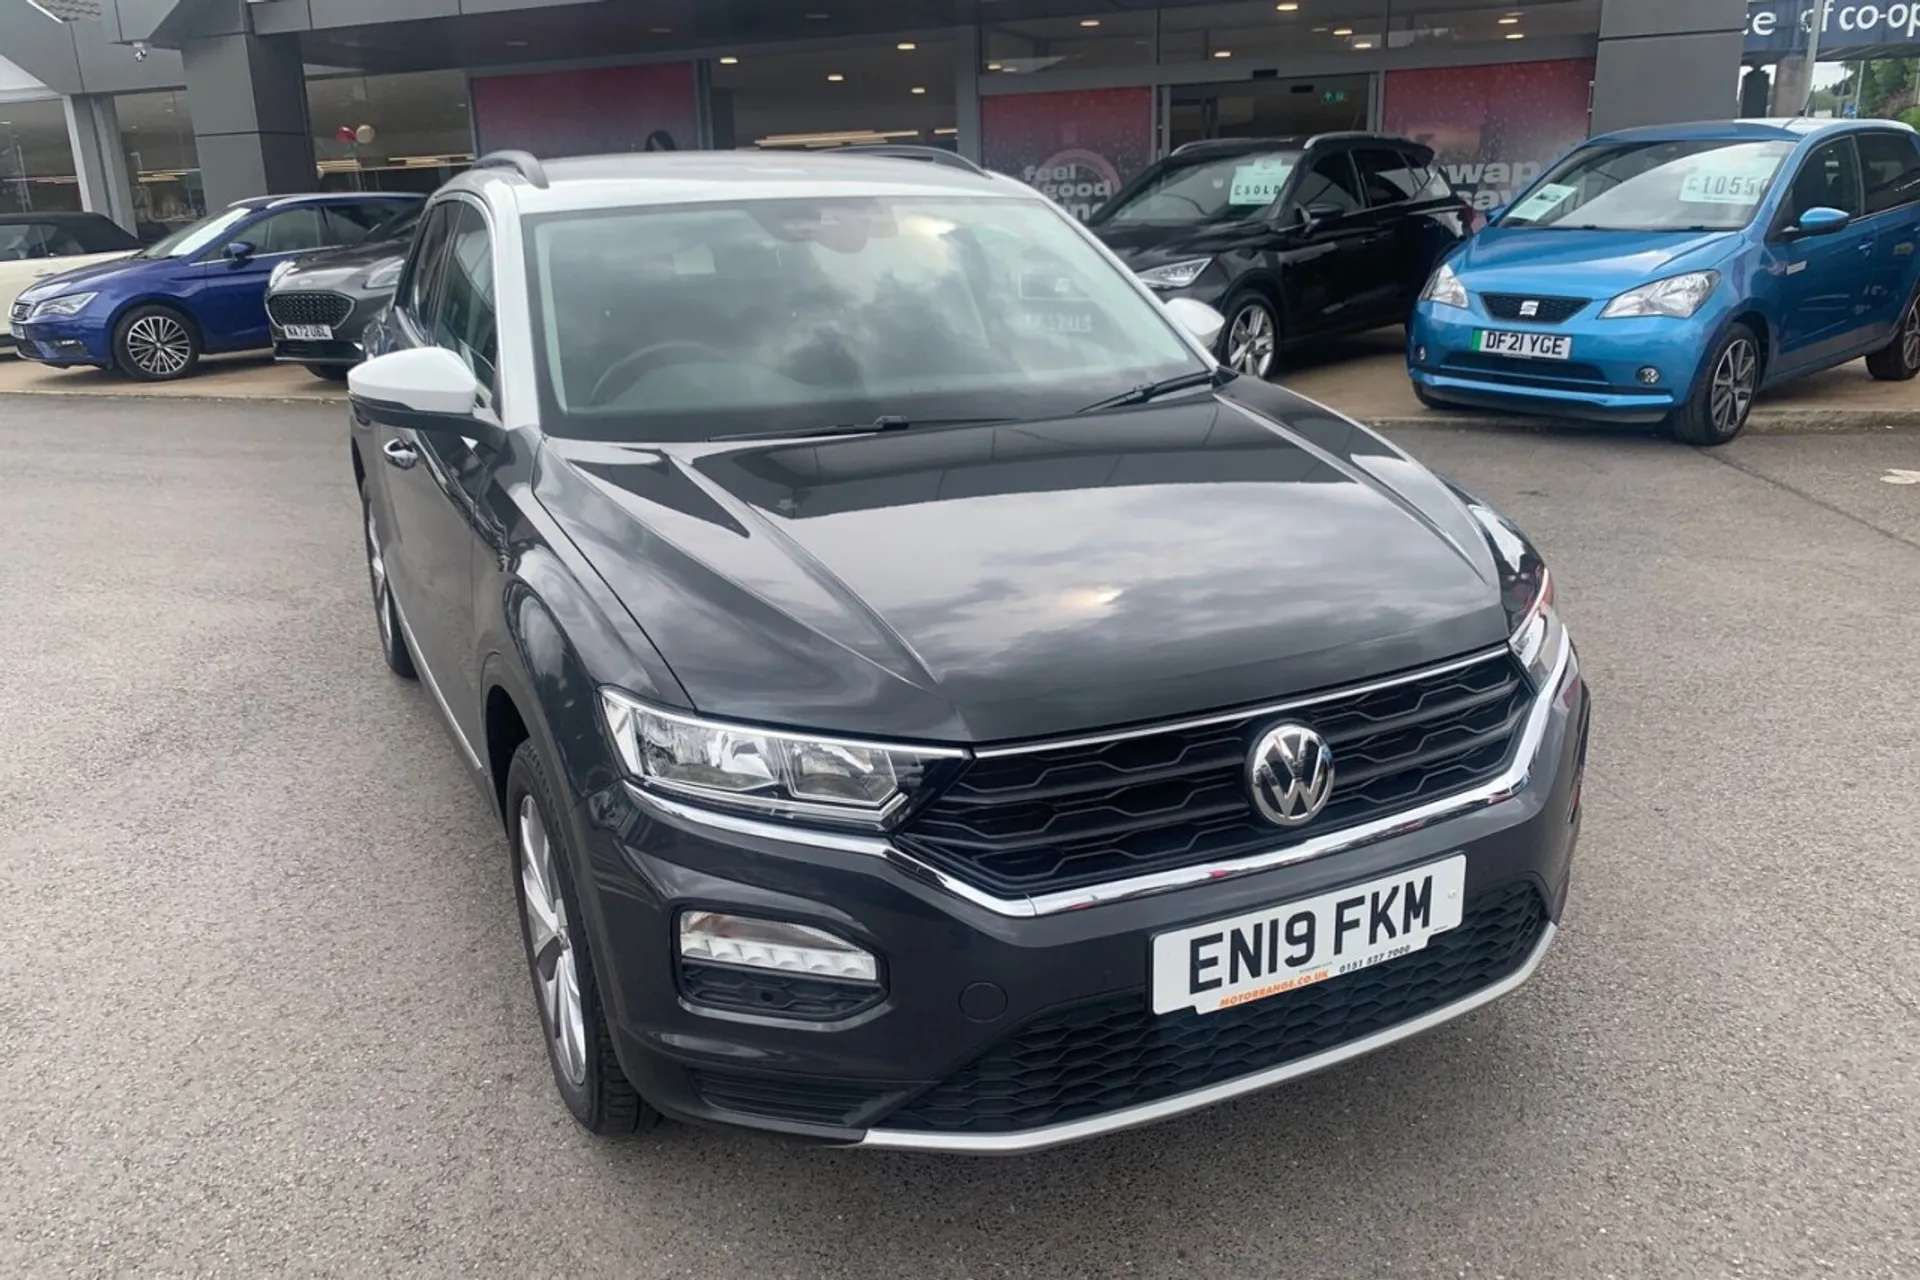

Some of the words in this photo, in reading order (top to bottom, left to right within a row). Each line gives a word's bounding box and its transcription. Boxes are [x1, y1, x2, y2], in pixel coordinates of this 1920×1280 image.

[1024, 164, 1076, 181] feel
[1440, 162, 1541, 190] wap
[1043, 179, 1112, 201] good
[1485, 332, 1525, 352] DF21
[1530, 335, 1565, 355] YGE
[1189, 910, 1316, 995] EN19
[1333, 875, 1433, 956] FKM
